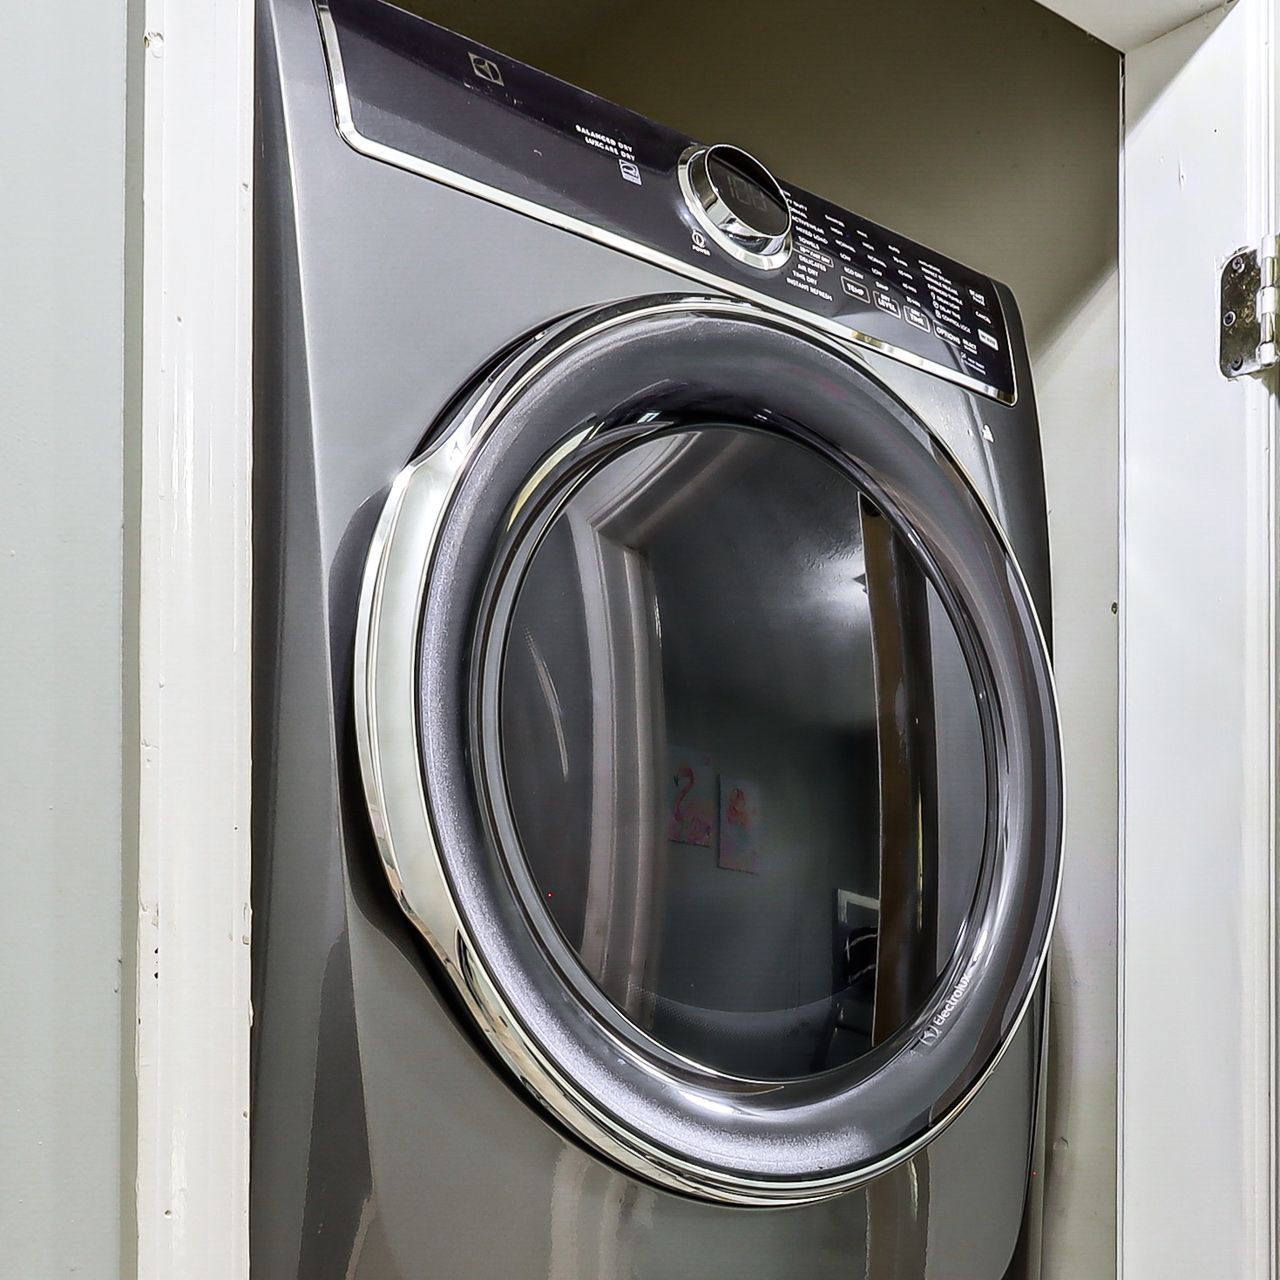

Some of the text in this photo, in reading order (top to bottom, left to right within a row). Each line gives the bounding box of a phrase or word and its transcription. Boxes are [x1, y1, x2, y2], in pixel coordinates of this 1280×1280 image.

[576, 124, 632, 152] BALANCED DRY
[585, 136, 635, 162] LUXCARE DRY
[933, 974, 970, 1026] Electrolux
